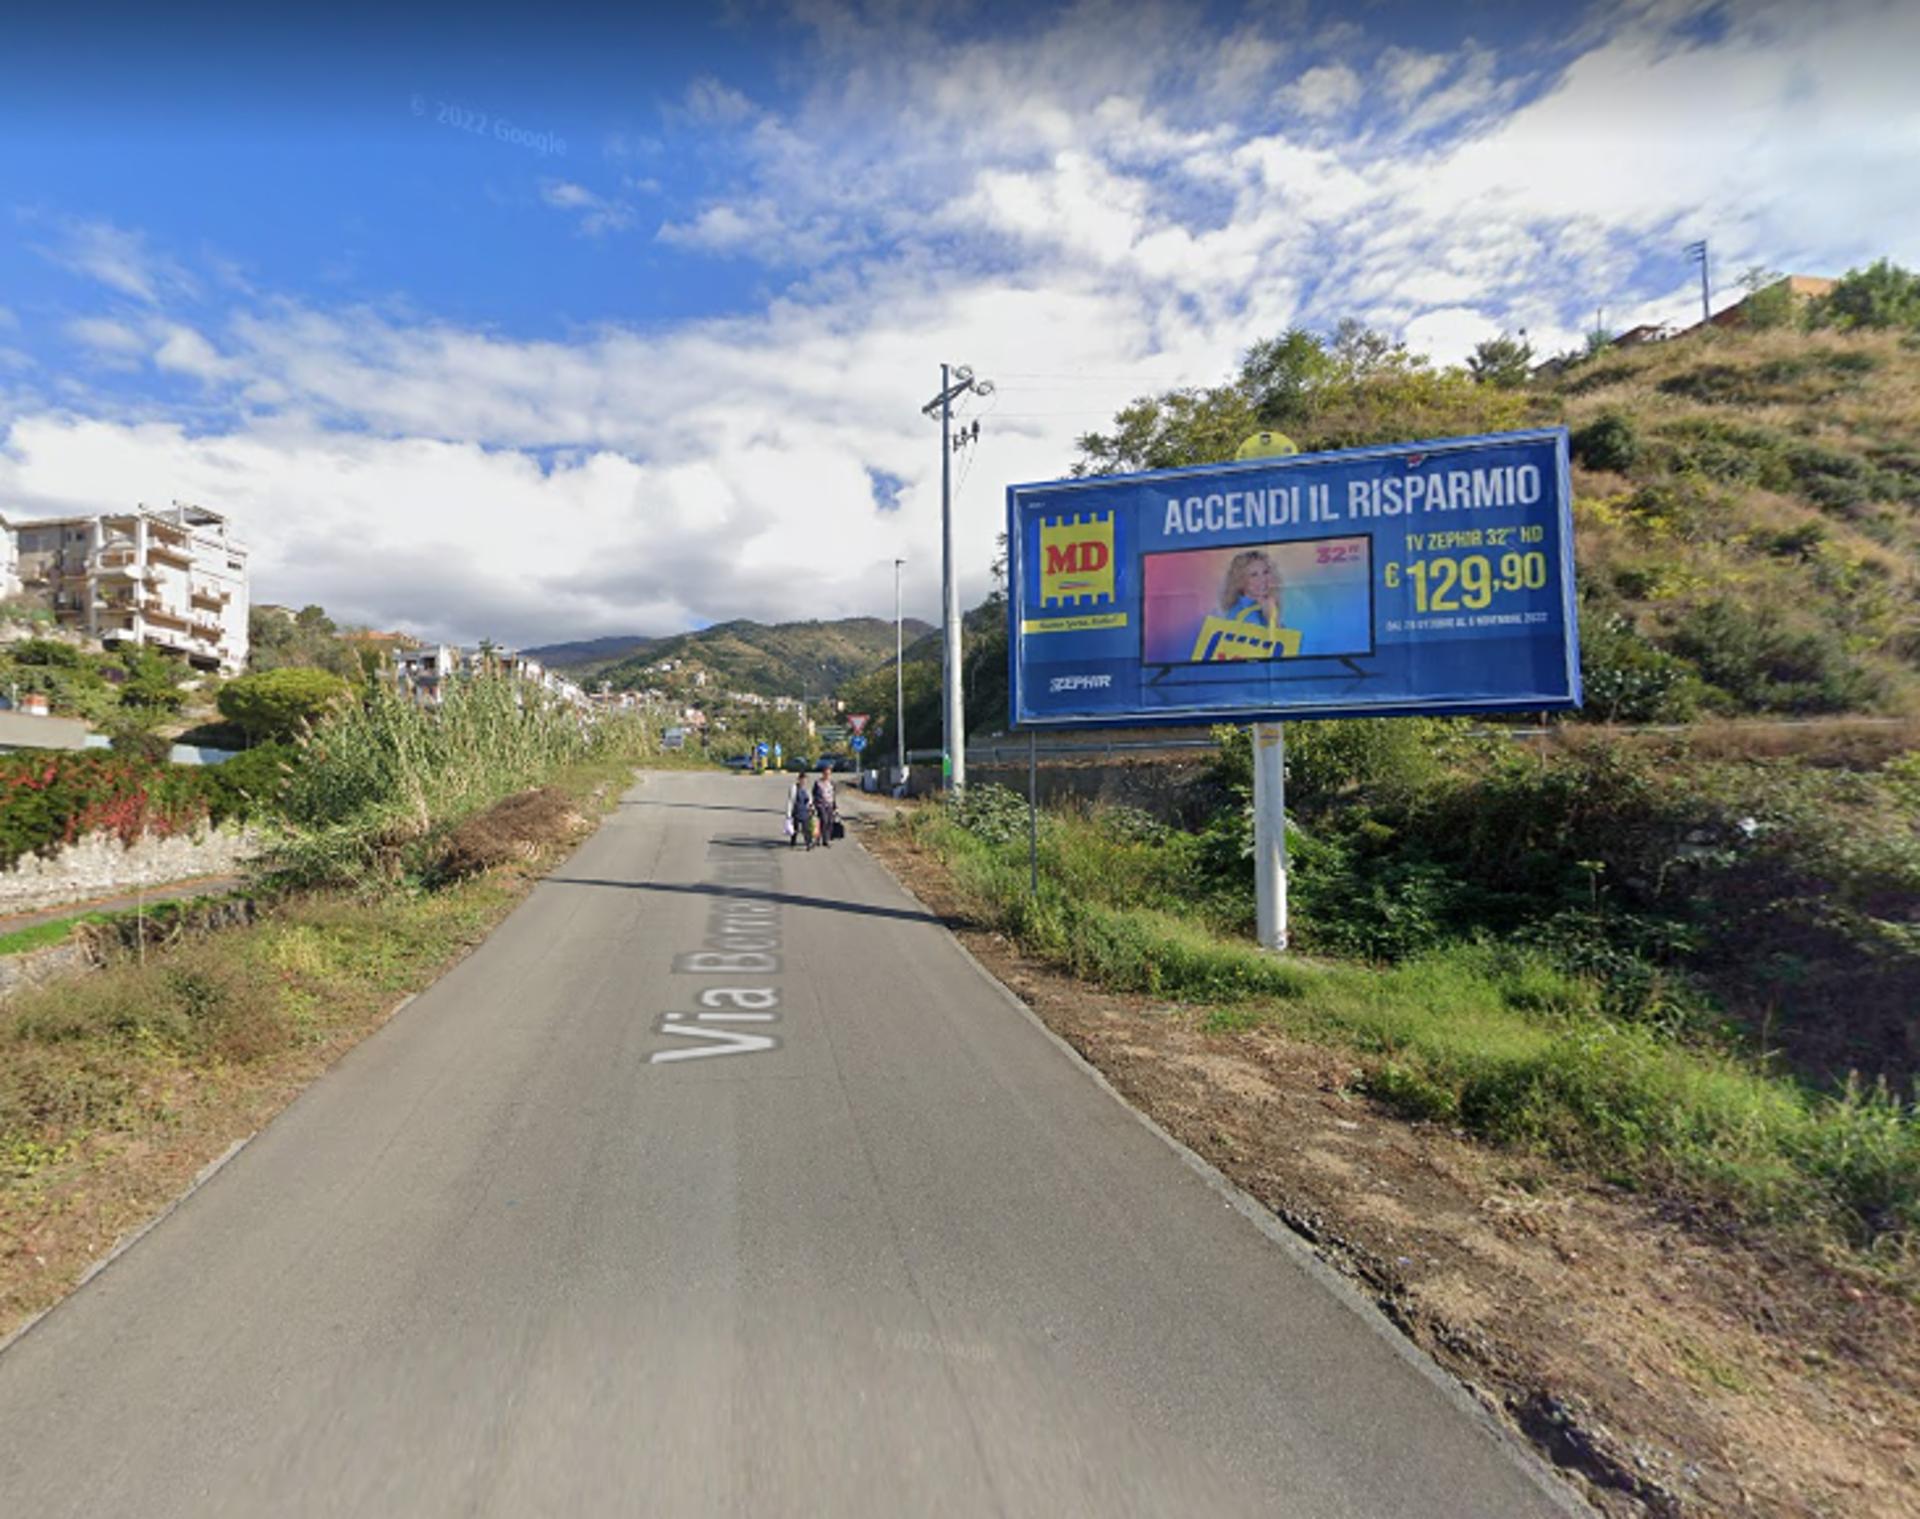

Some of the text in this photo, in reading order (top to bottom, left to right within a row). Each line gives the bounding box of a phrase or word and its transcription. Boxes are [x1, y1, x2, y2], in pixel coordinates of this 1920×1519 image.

[1163, 465, 1541, 535] ACCENDI IL RISPARMIO
[1045, 541, 1108, 576] MD
[1405, 534, 1424, 550] TV
[1428, 529, 1483, 550] ZEPHIR
[1521, 525, 1544, 543] HD
[1384, 551, 1547, 613] € 129,90
